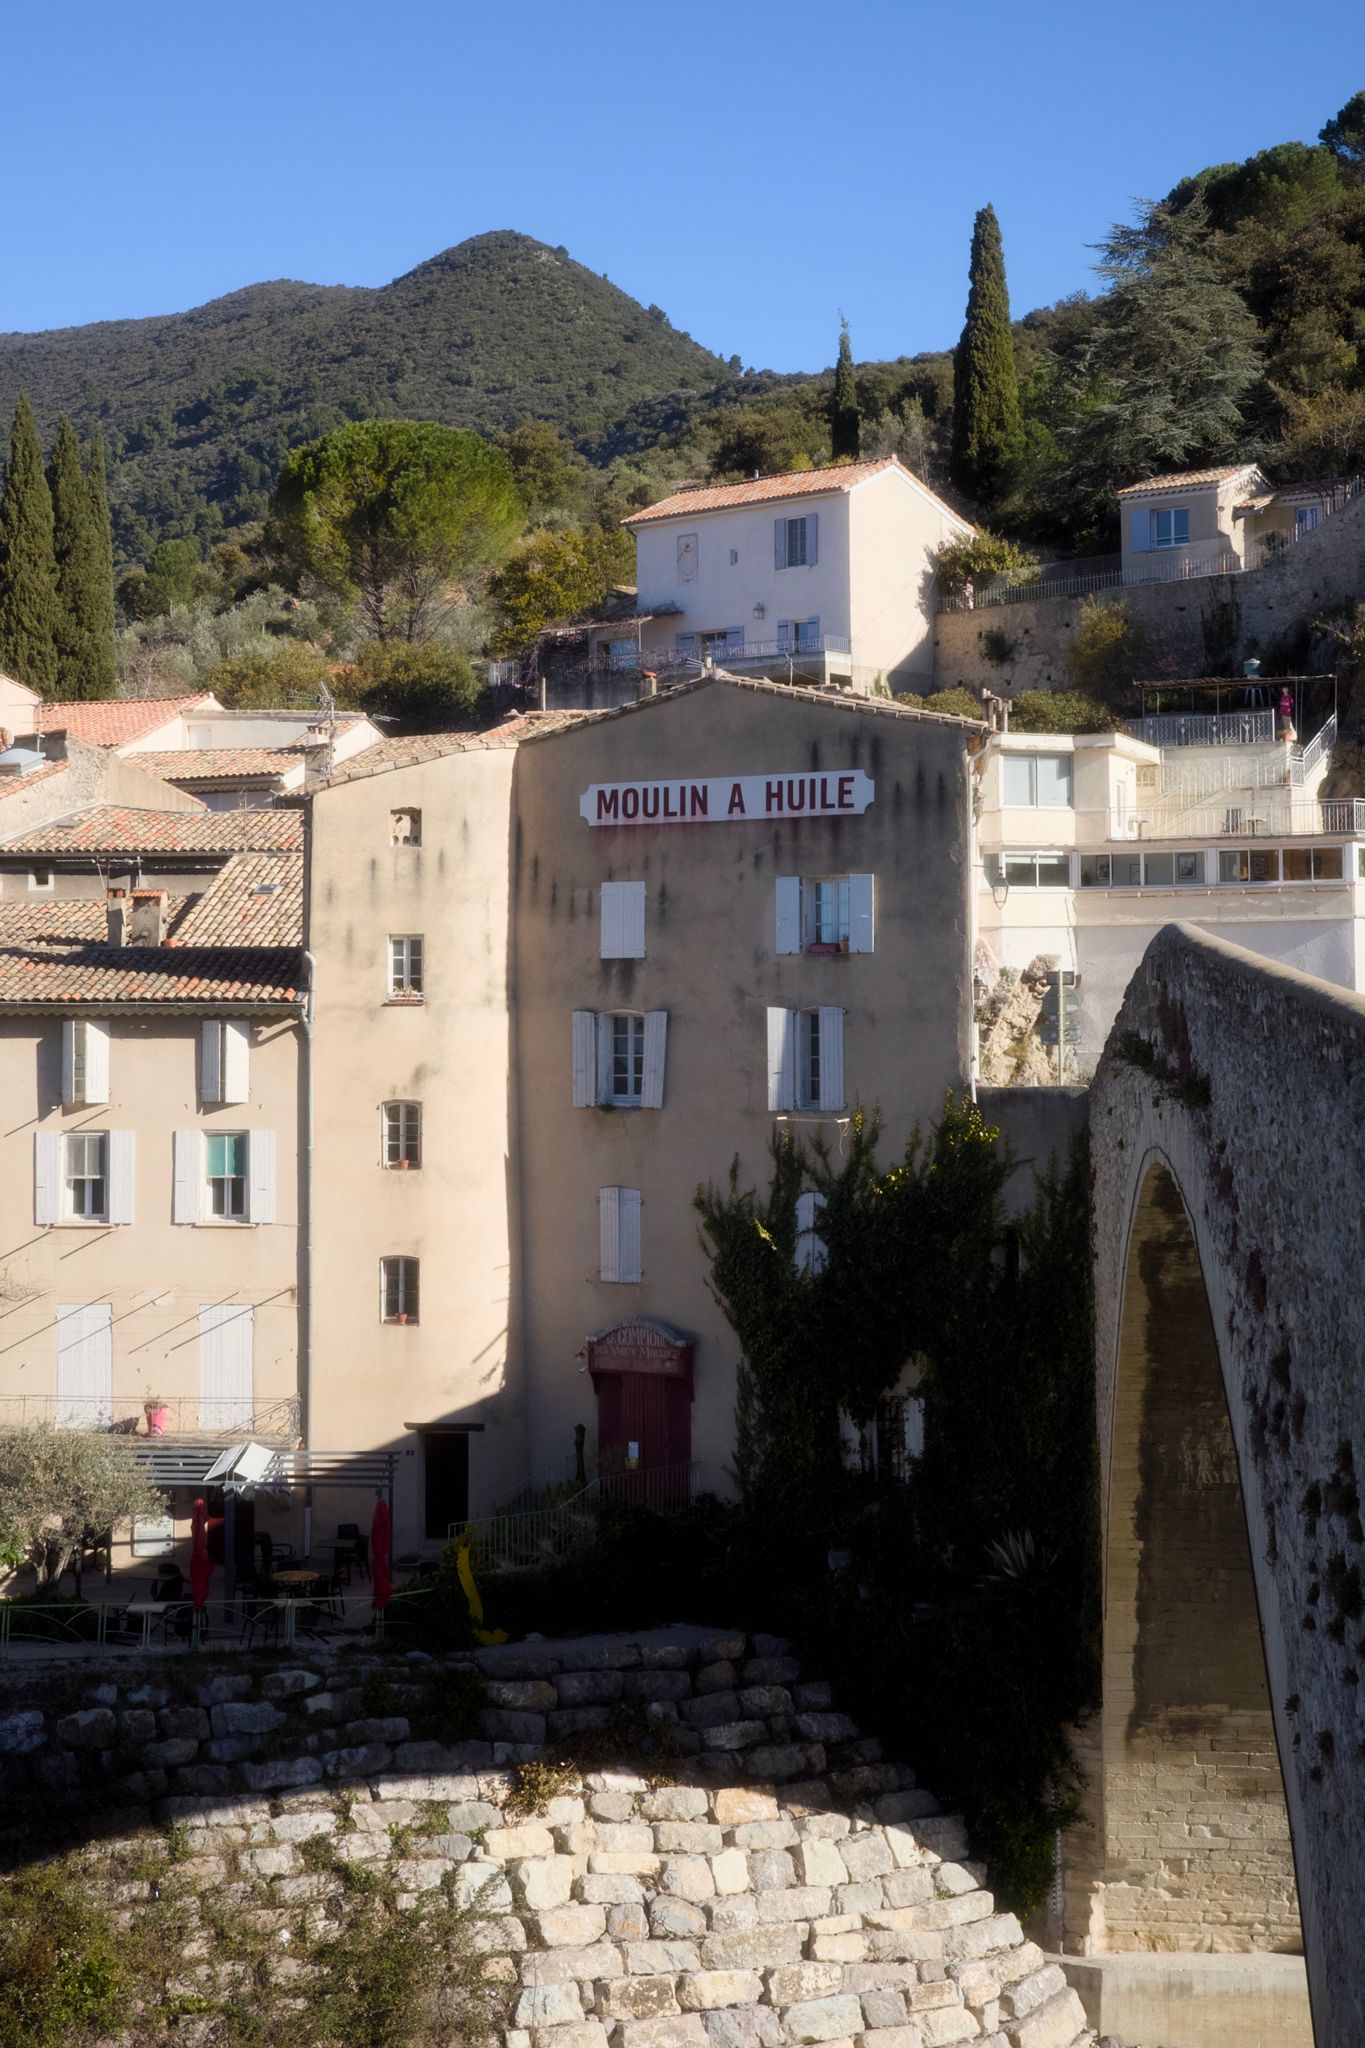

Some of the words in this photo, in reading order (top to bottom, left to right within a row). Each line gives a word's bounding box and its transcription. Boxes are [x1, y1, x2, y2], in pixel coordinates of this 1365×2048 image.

[597, 785, 708, 820] MOULIN
[728, 783, 746, 814] A
[766, 776, 855, 812] HUILE
